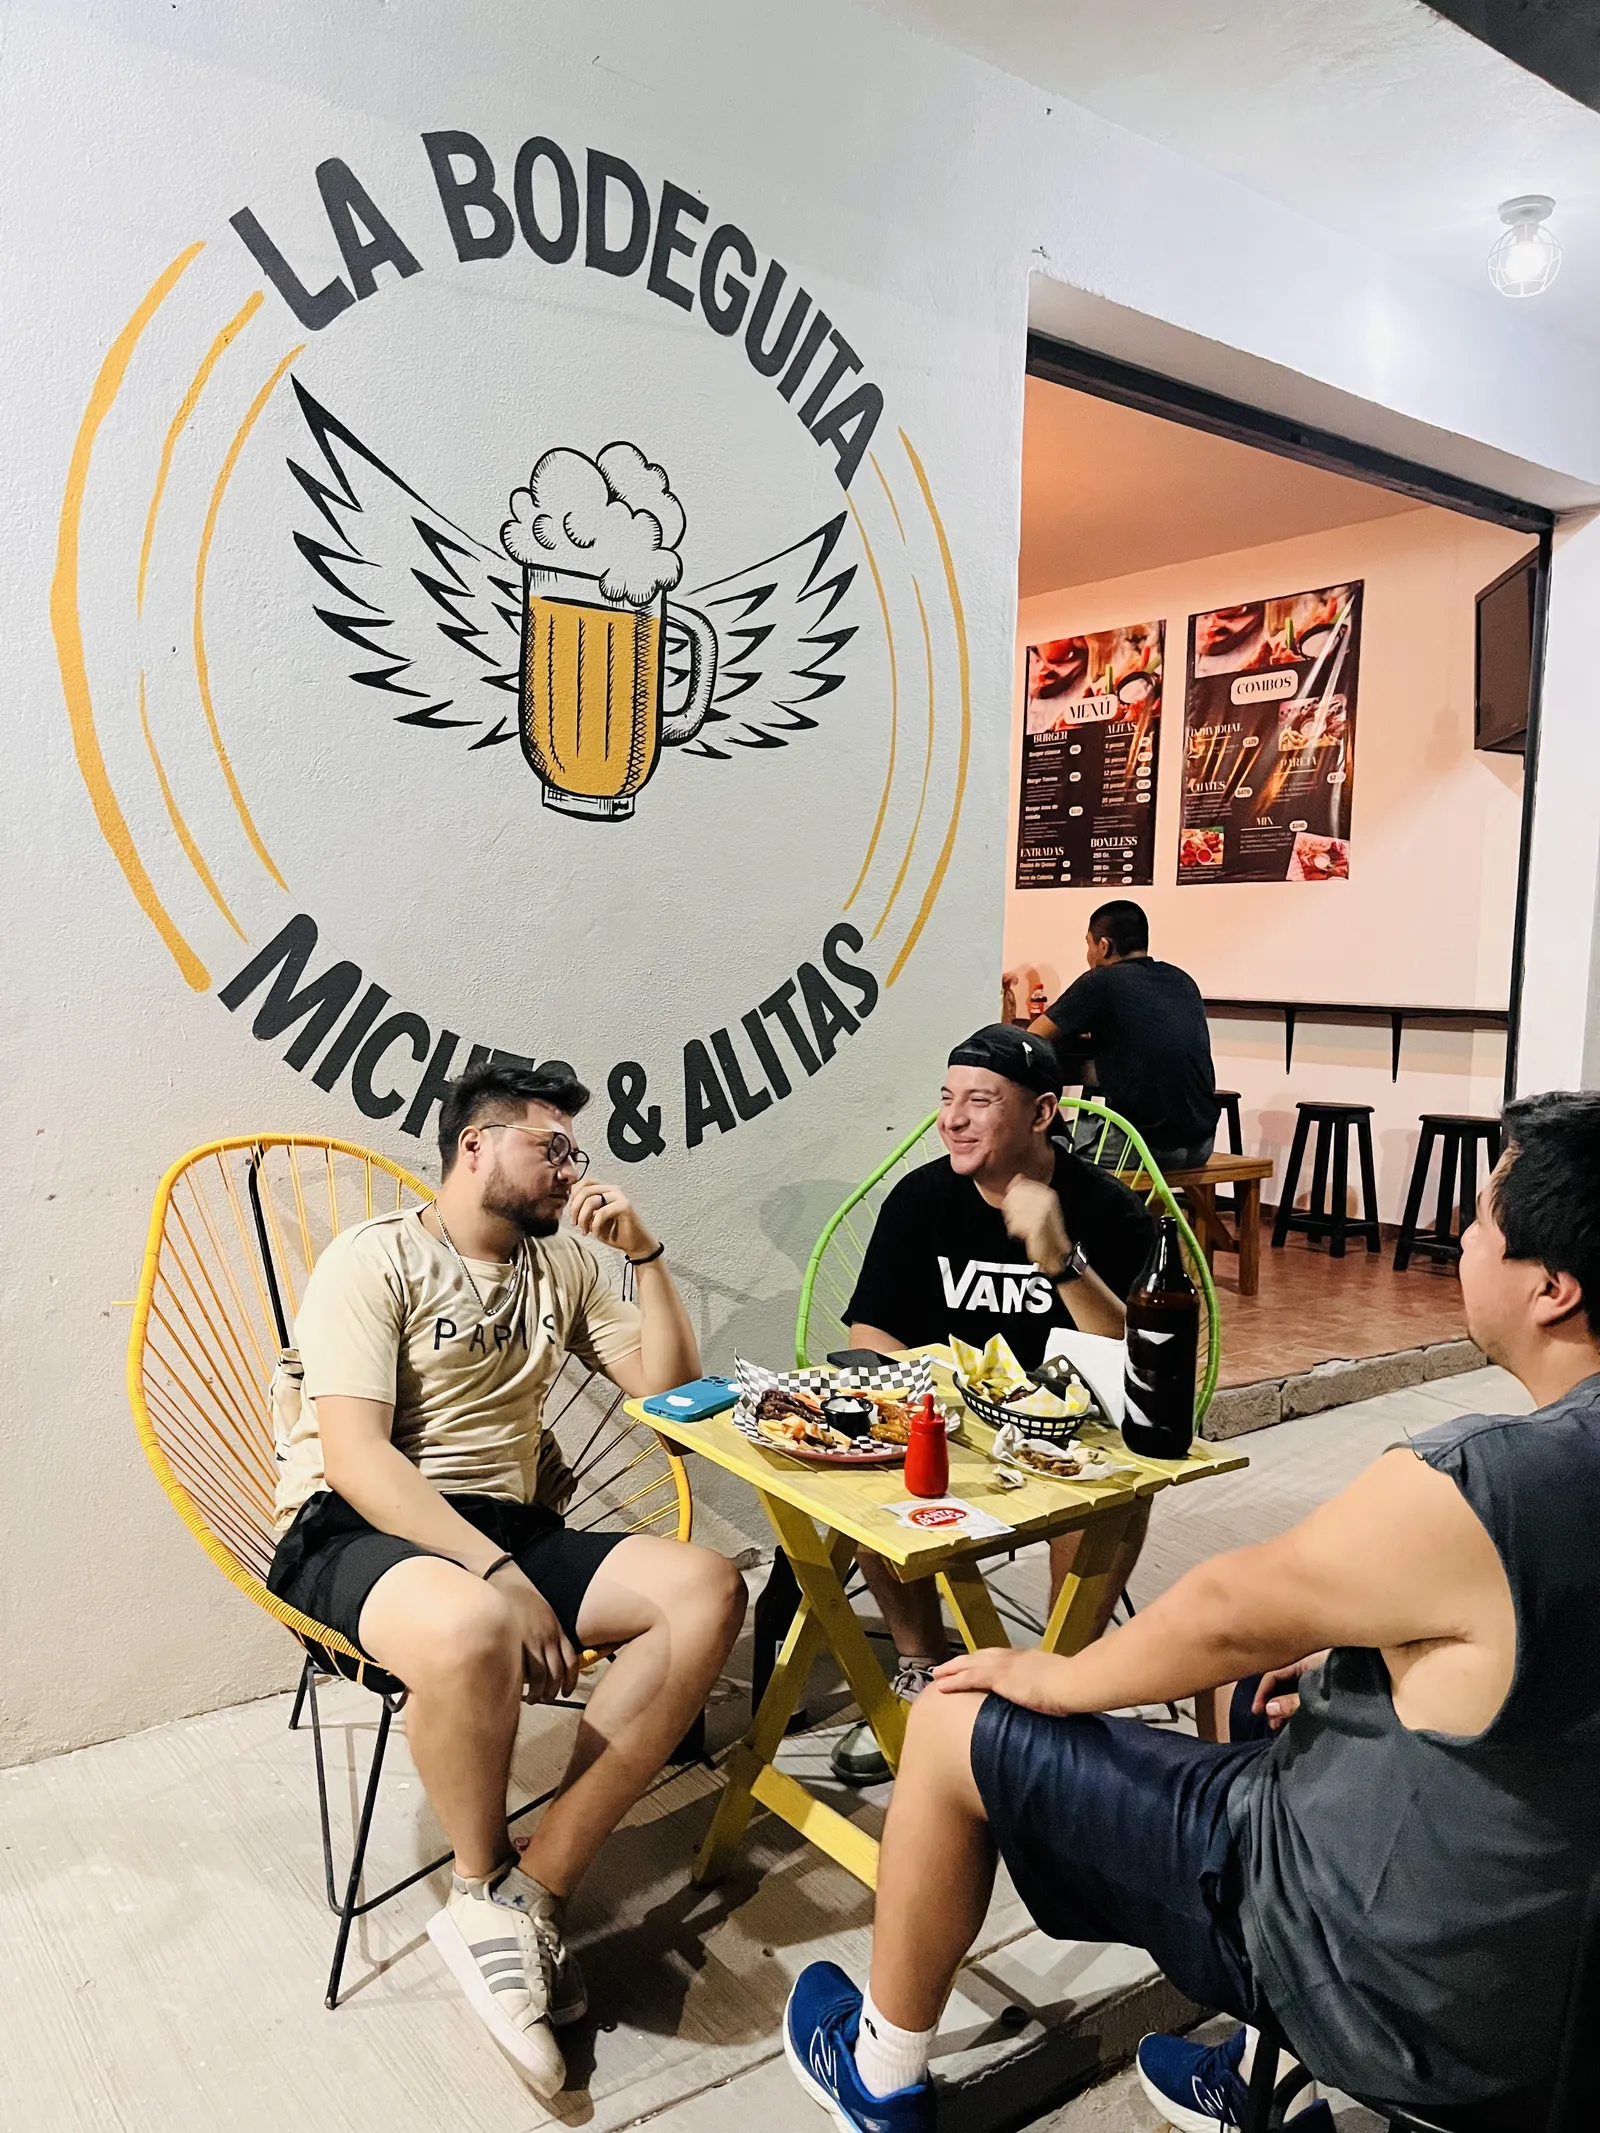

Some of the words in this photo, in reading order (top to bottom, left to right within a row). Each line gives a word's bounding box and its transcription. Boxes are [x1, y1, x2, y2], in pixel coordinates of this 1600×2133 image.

[229, 157, 423, 331] LA
[421, 130, 884, 491] BODEGUITA
[1236, 676, 1292, 696] COMBOS
[1069, 697, 1111, 720] MENÚ
[1033, 731, 1068, 744] BURGER
[1256, 816, 1274, 826] MIX
[1020, 846, 1065, 857] ENTRADAS
[1090, 836, 1138, 848] BONELESS
[218, 913, 580, 1138] MICH
[607, 1060, 666, 1162] &
[683, 922, 879, 1149] ALITAS
[937, 1256, 1053, 1314] VANS
[434, 1314, 556, 1354] PARIS
